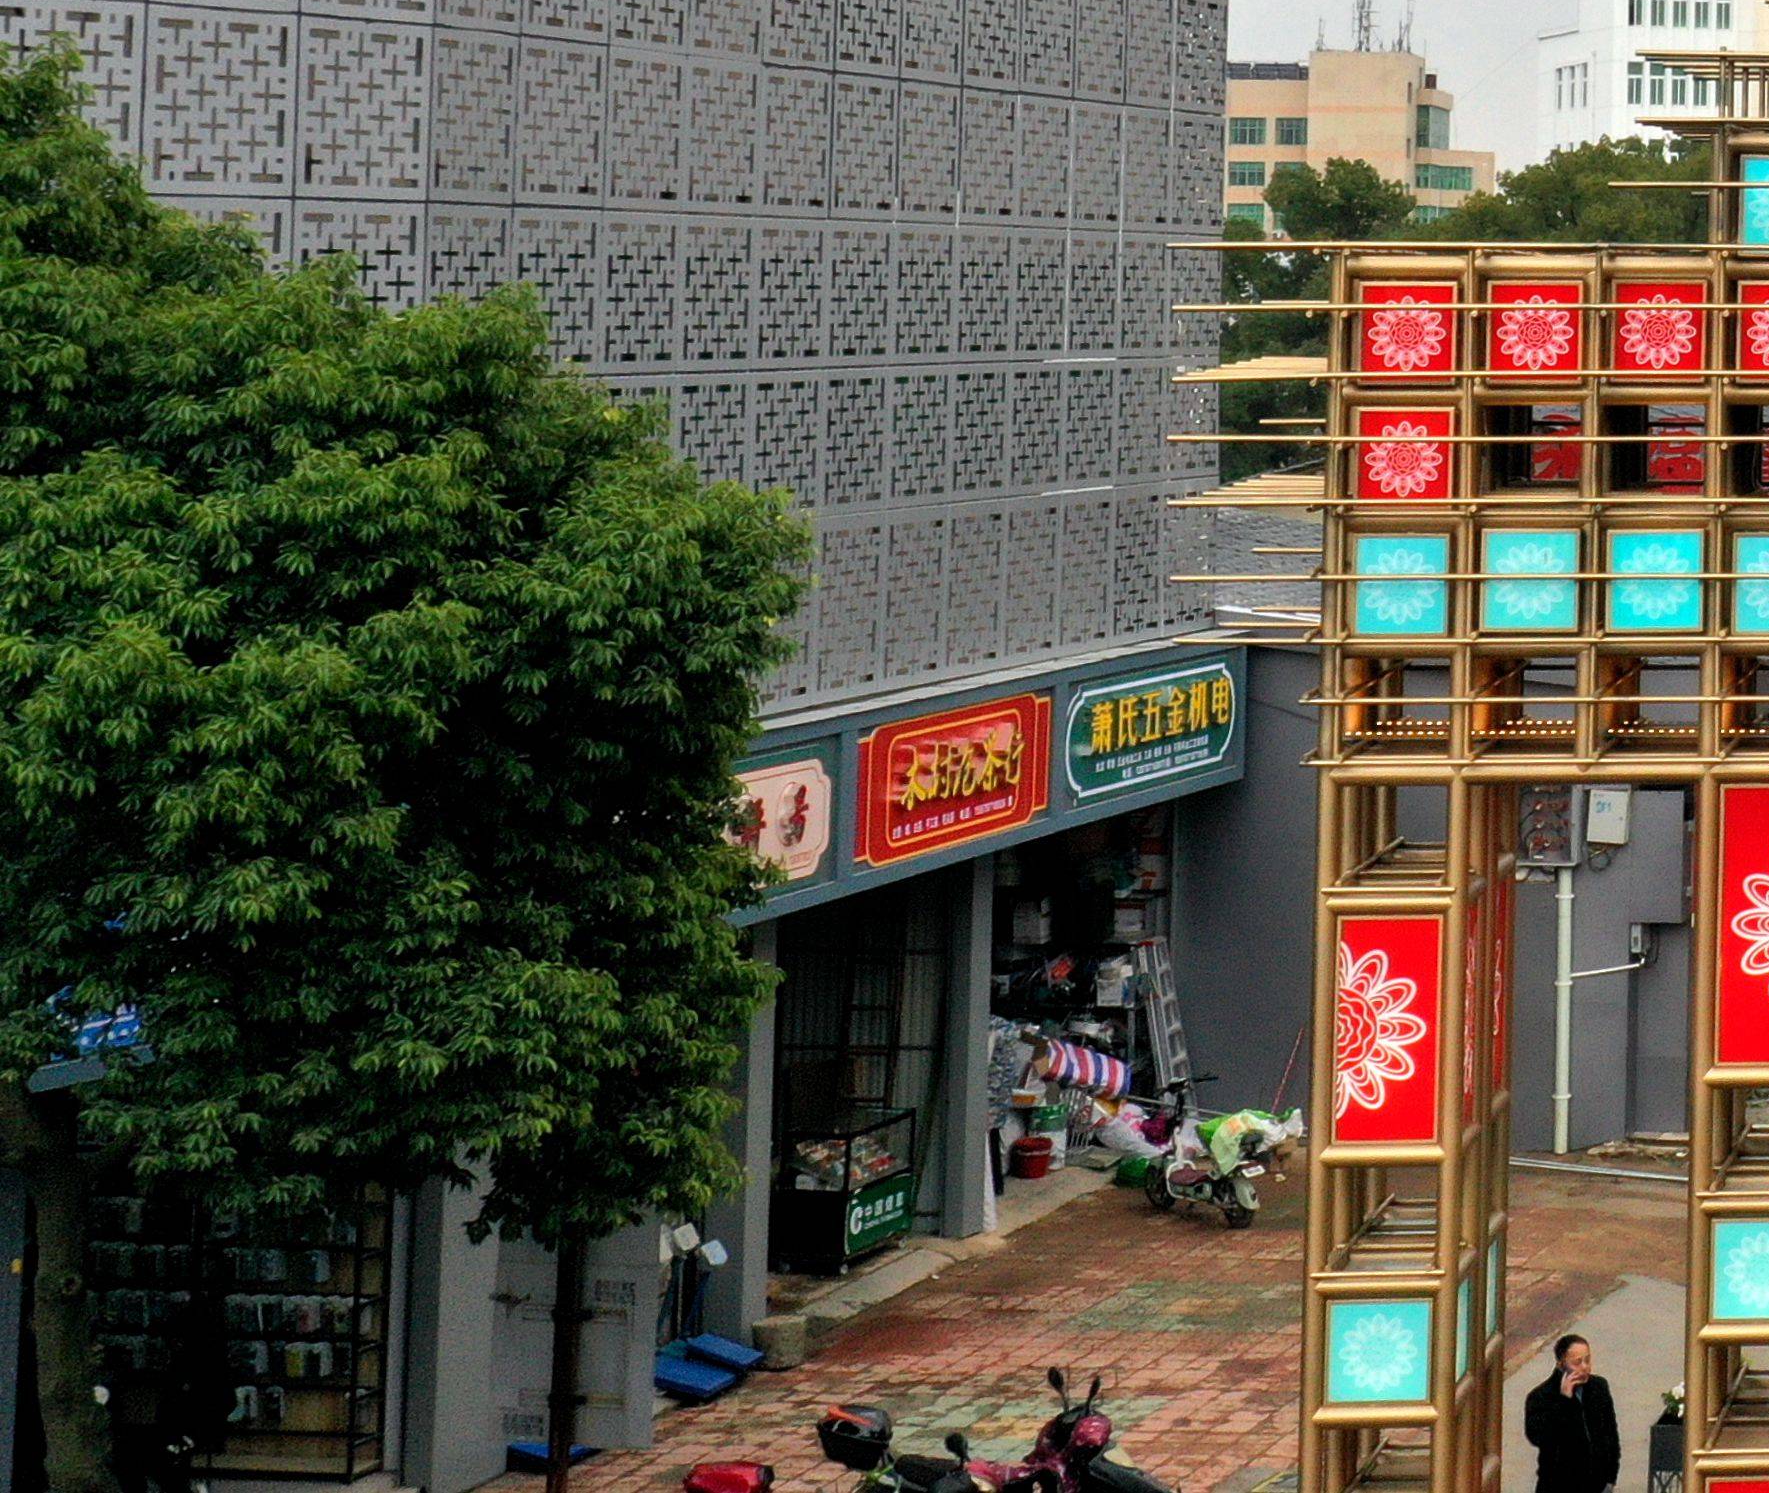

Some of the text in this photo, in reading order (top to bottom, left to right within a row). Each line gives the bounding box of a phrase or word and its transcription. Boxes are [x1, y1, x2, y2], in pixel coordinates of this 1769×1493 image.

[1090, 676, 1231, 755] 萧氏五金机电
